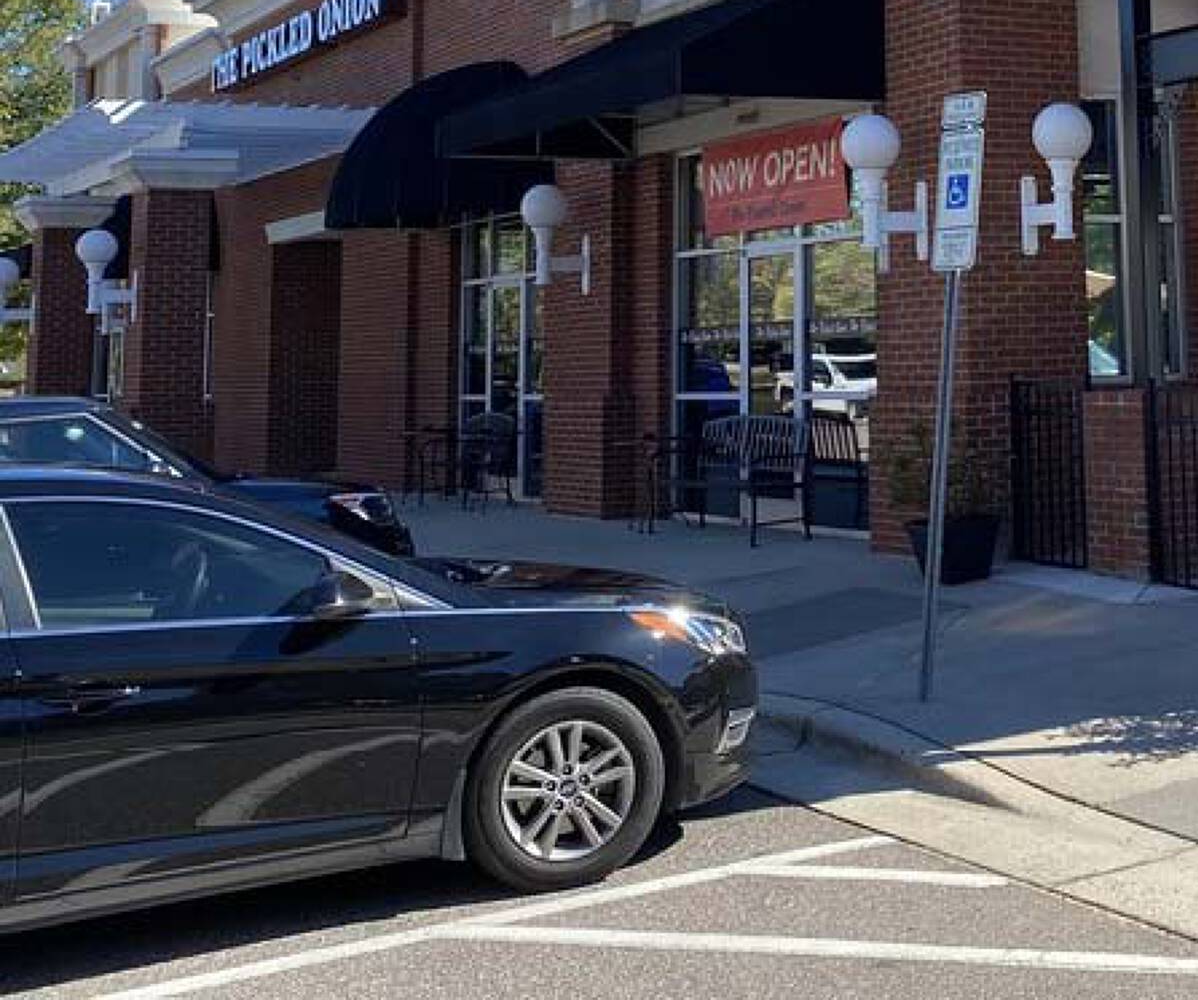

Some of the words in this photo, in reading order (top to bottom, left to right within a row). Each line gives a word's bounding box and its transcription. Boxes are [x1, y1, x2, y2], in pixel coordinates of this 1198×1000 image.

[211, 46, 240, 94] THE
[241, 10, 312, 80] PICKLED
[710, 155, 760, 198] NOW
[764, 136, 838, 188] OPEN!
